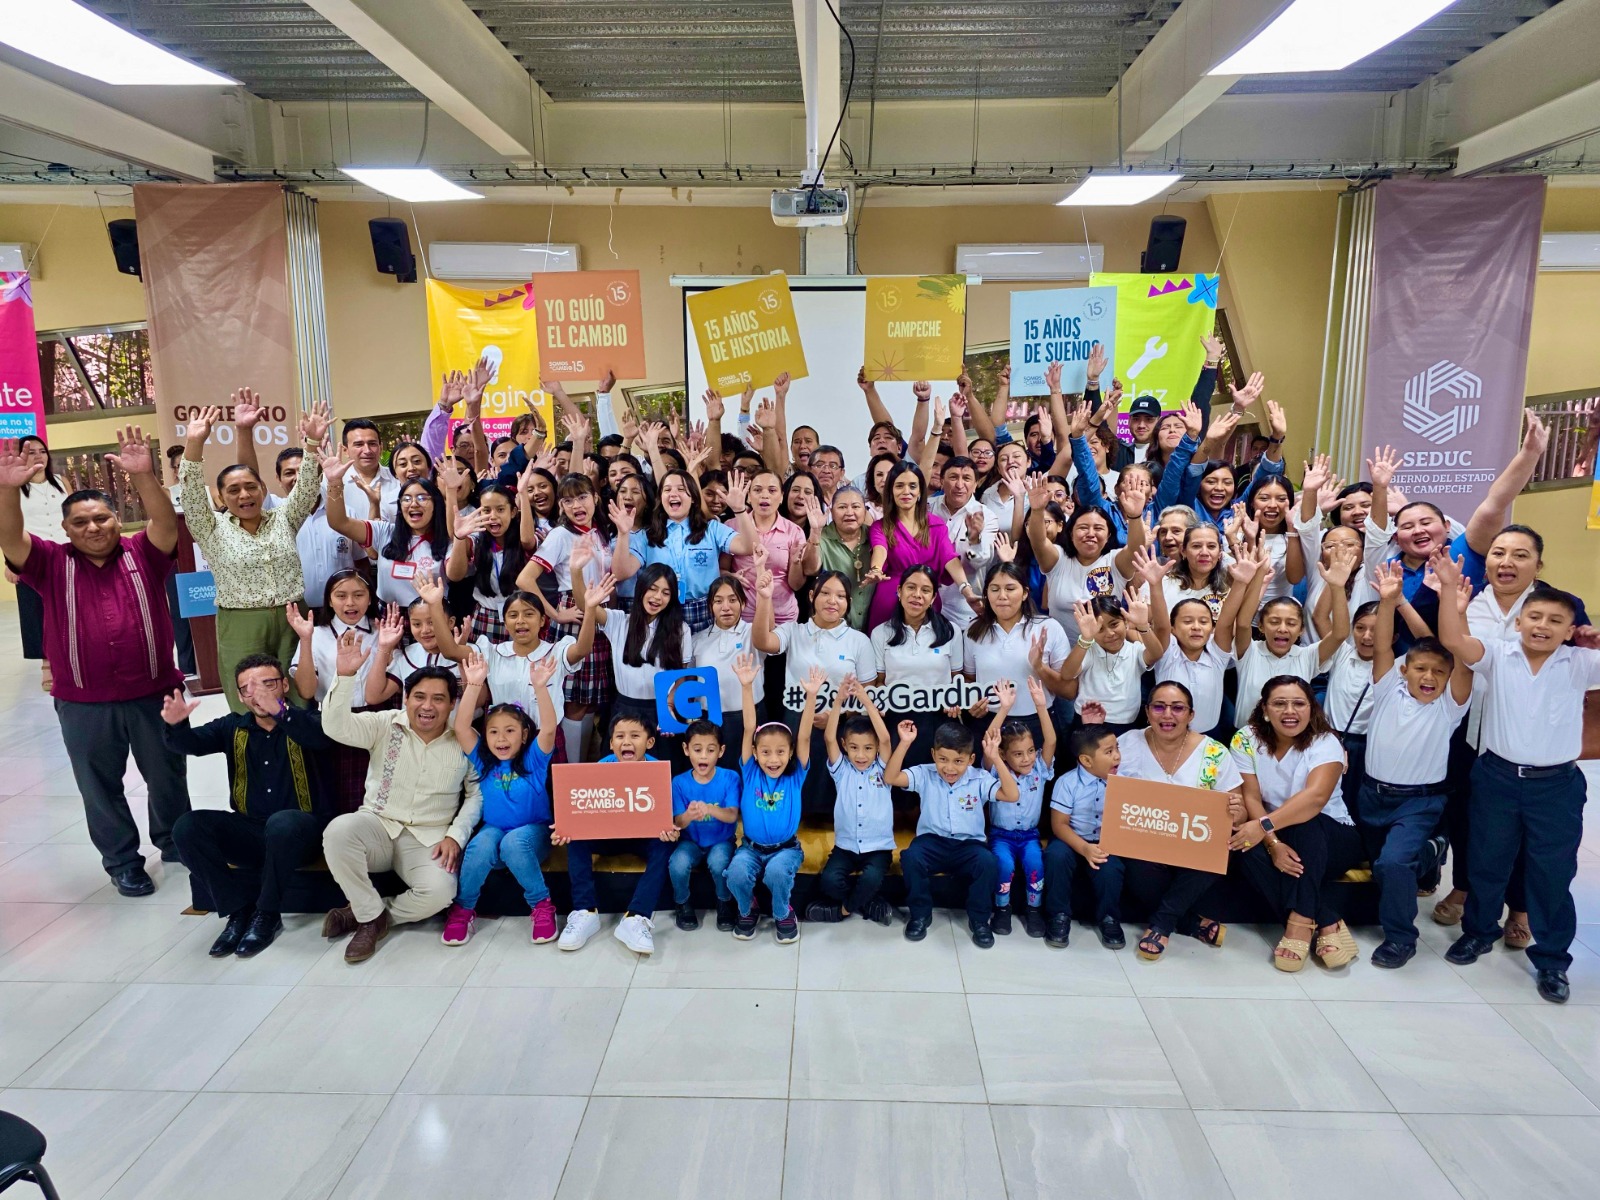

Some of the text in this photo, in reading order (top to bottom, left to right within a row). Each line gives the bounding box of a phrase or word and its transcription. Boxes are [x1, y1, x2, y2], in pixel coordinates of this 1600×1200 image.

[611, 285, 627, 301] 15
[762, 294, 778, 310] 15
[881, 290, 897, 307] 15
[544, 294, 605, 322] YO GUÍO
[1087, 302, 1102, 316] 15
[704, 310, 759, 340] 15 AÑOS
[888, 320, 942, 338] CAMPECHE
[1024, 314, 1081, 340] 15 AÑOS
[547, 323, 628, 348] EL CAMBIO
[709, 326, 792, 363] DE HISTORIA
[1024, 338, 1100, 363] DE SUEÑO
[458, 384, 546, 414] agina
[174, 405, 287, 422] GOIENO
[0, 427, 33, 435] ntorno?
[204, 425, 289, 445] OOS
[1403, 450, 1473, 468] SEDUC
[1390, 473, 1496, 484] BIERNO DEL ESTADO
[1413, 484, 1473, 494] CAMPECHE
[193, 592, 216, 600] CAMB
[786, 677, 1016, 711] #SomosGardne
[570, 787, 616, 800] SOMOS
[624, 786, 652, 813] 15
[576, 798, 626, 810] CAMBIO
[1121, 803, 1170, 821] SOMOS
[1180, 812, 1209, 842] 15
[1126, 814, 1179, 833] CAMBIO
